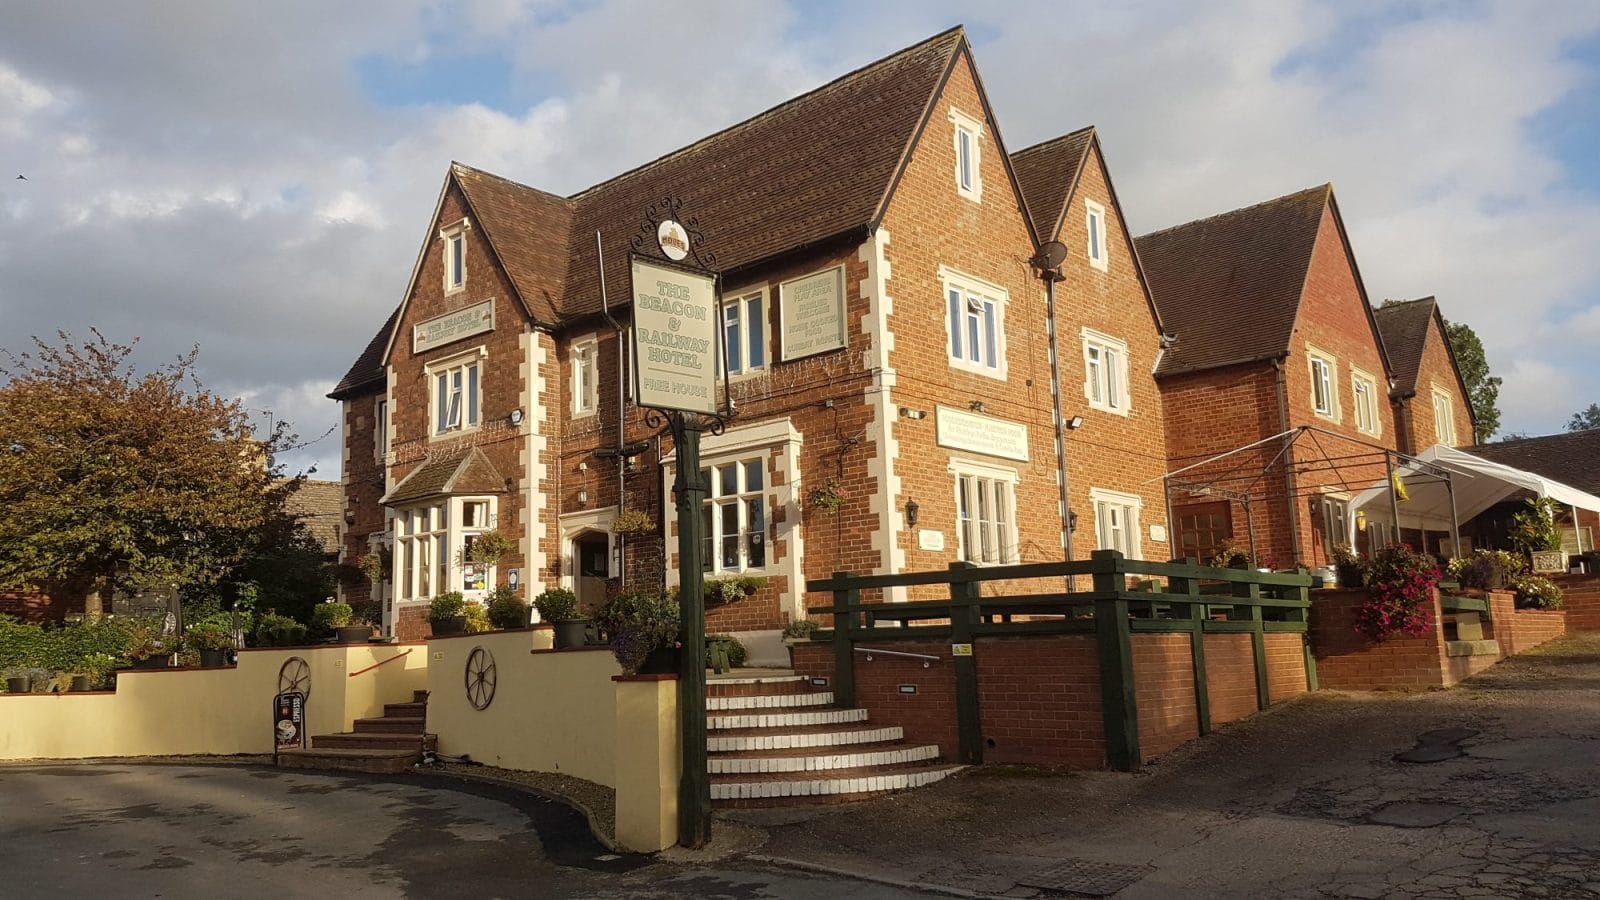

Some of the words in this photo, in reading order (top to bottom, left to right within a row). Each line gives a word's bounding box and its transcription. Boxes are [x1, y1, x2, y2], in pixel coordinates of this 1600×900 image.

[656, 281, 690, 301] THE
[811, 286, 832, 299] AREA
[638, 294, 707, 321] BEACON
[668, 317, 681, 332] &
[805, 326, 822, 337] FOOD
[637, 328, 710, 354] RAILWAY
[648, 347, 702, 370] HOTEL
[644, 377, 670, 393] FREE
[672, 382, 707, 398] HOUSE
